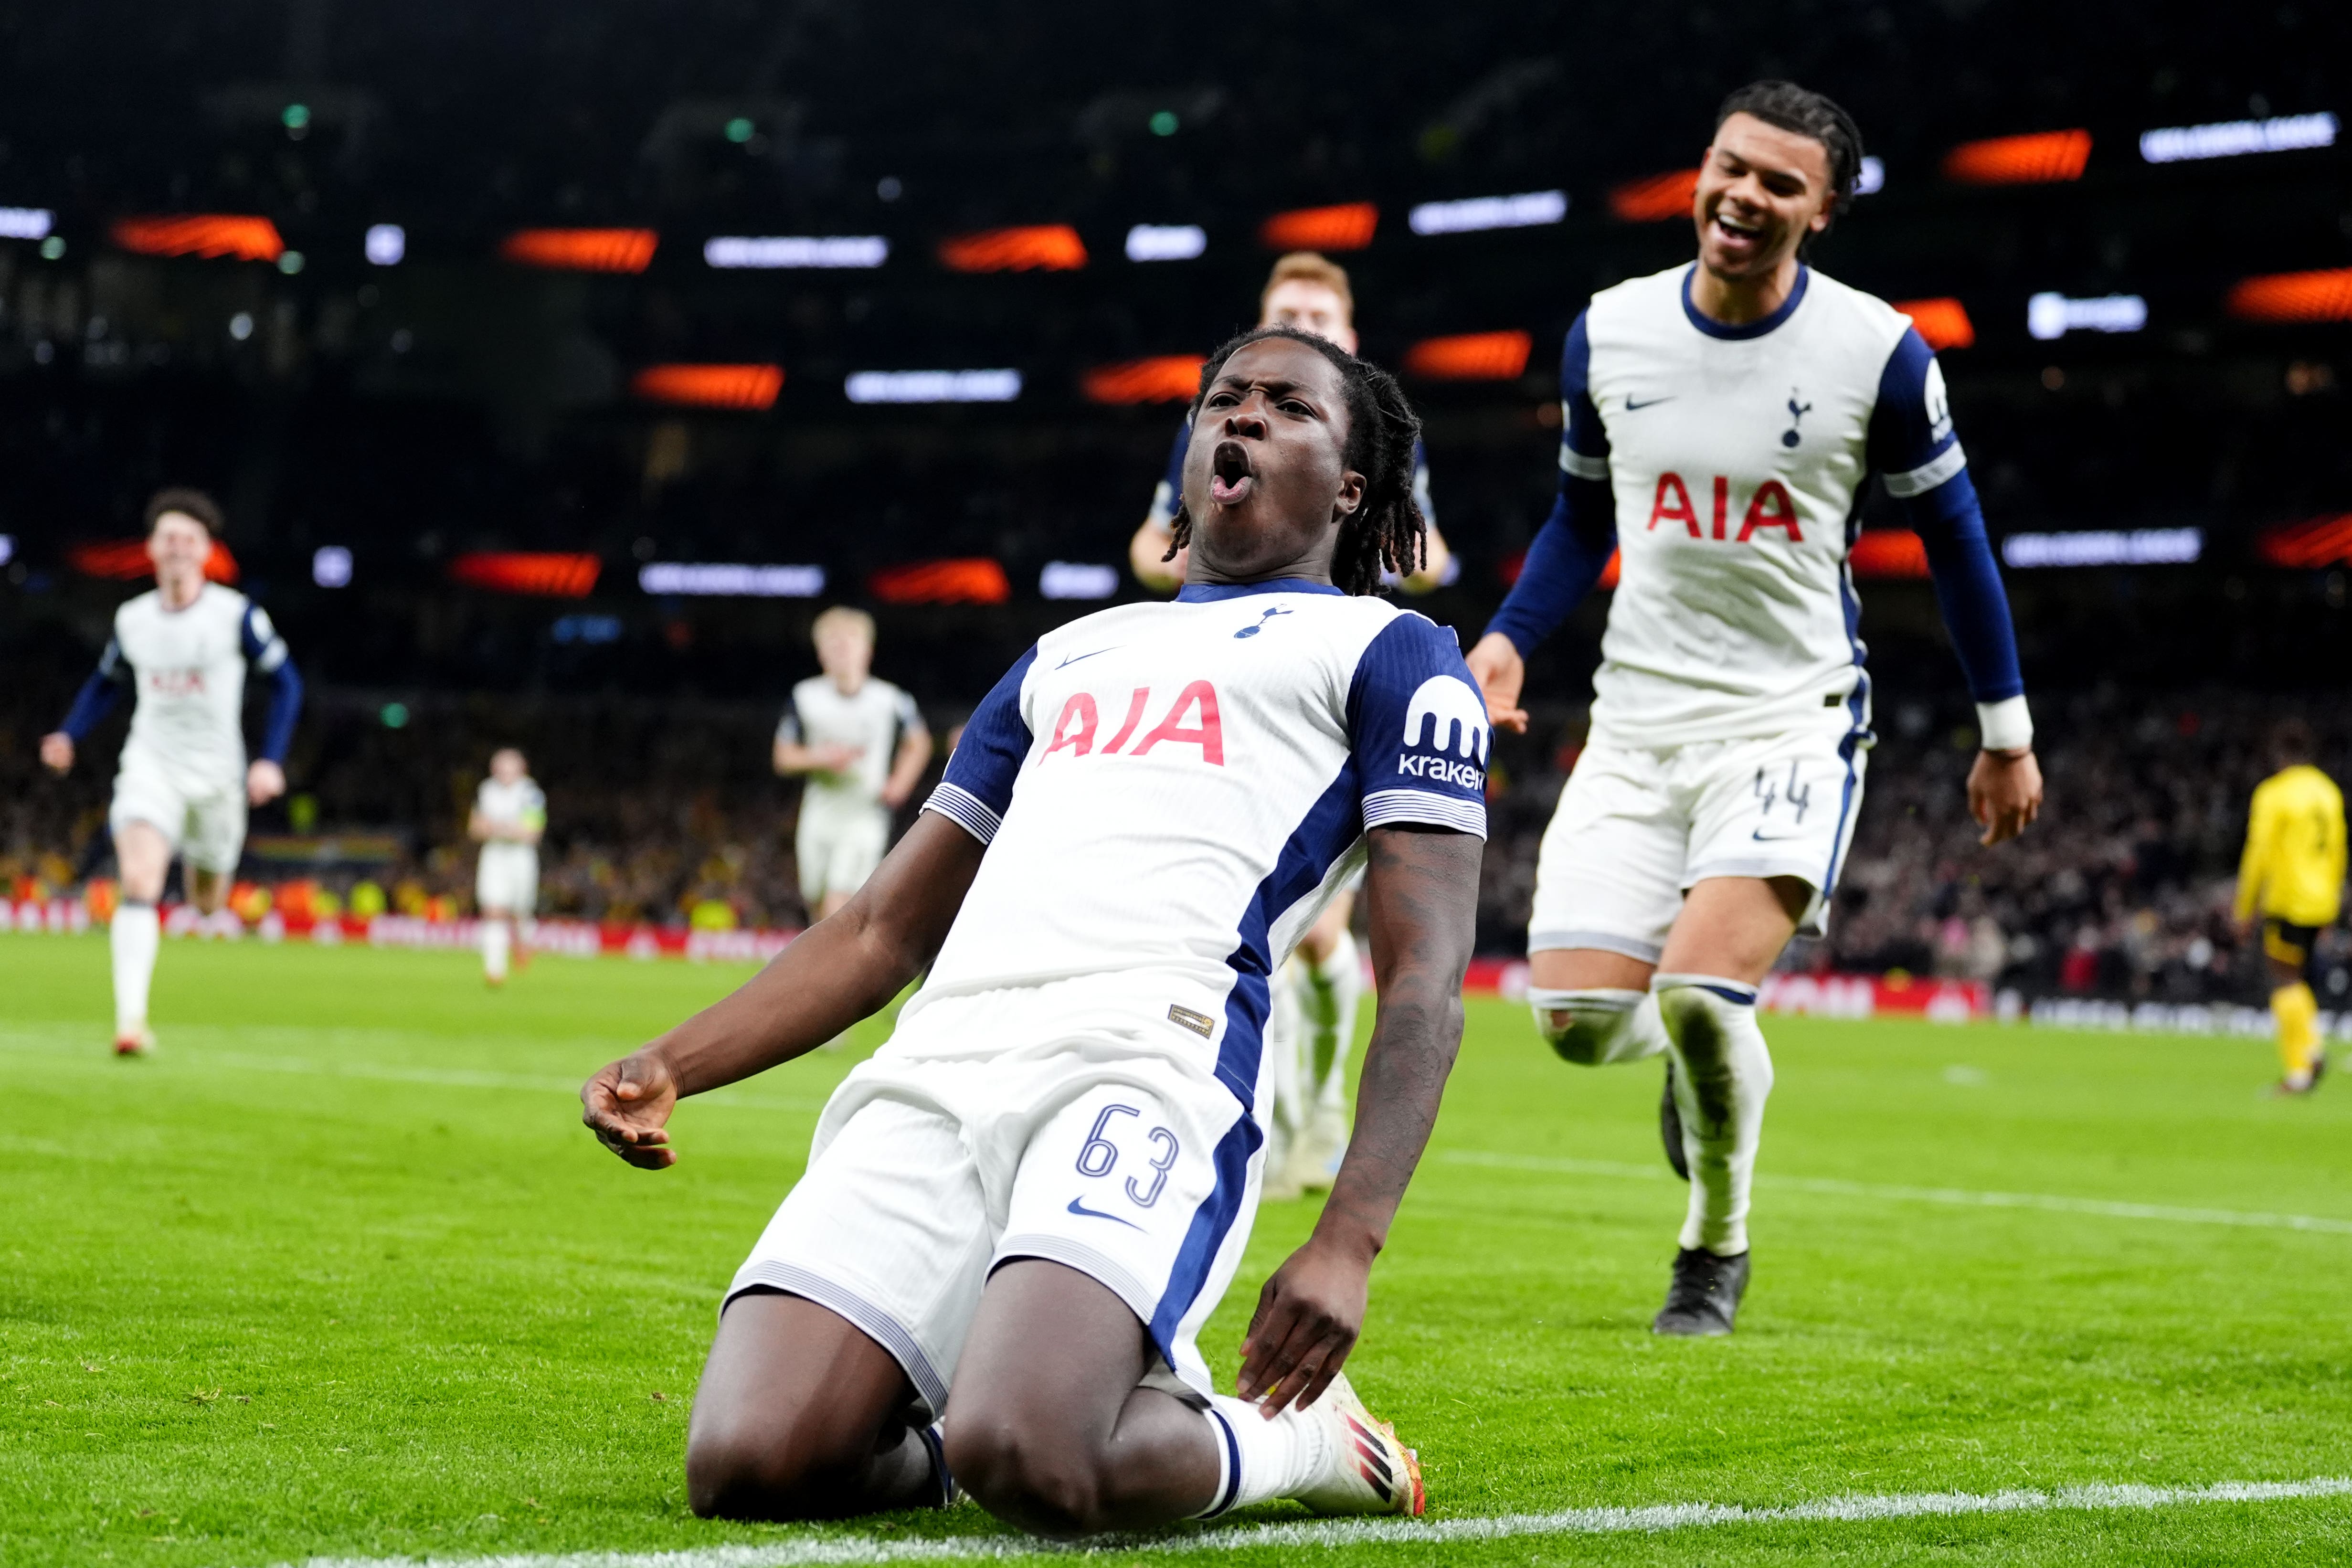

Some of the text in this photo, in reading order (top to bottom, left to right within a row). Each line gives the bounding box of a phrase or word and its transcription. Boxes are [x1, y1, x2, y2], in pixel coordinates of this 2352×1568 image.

[1647, 471, 1803, 542] AIA
[1037, 679, 1224, 767] AIA
[1398, 753, 1485, 790] kraken
[1754, 758, 1809, 825] 44
[1076, 1104, 1179, 1208] 63
